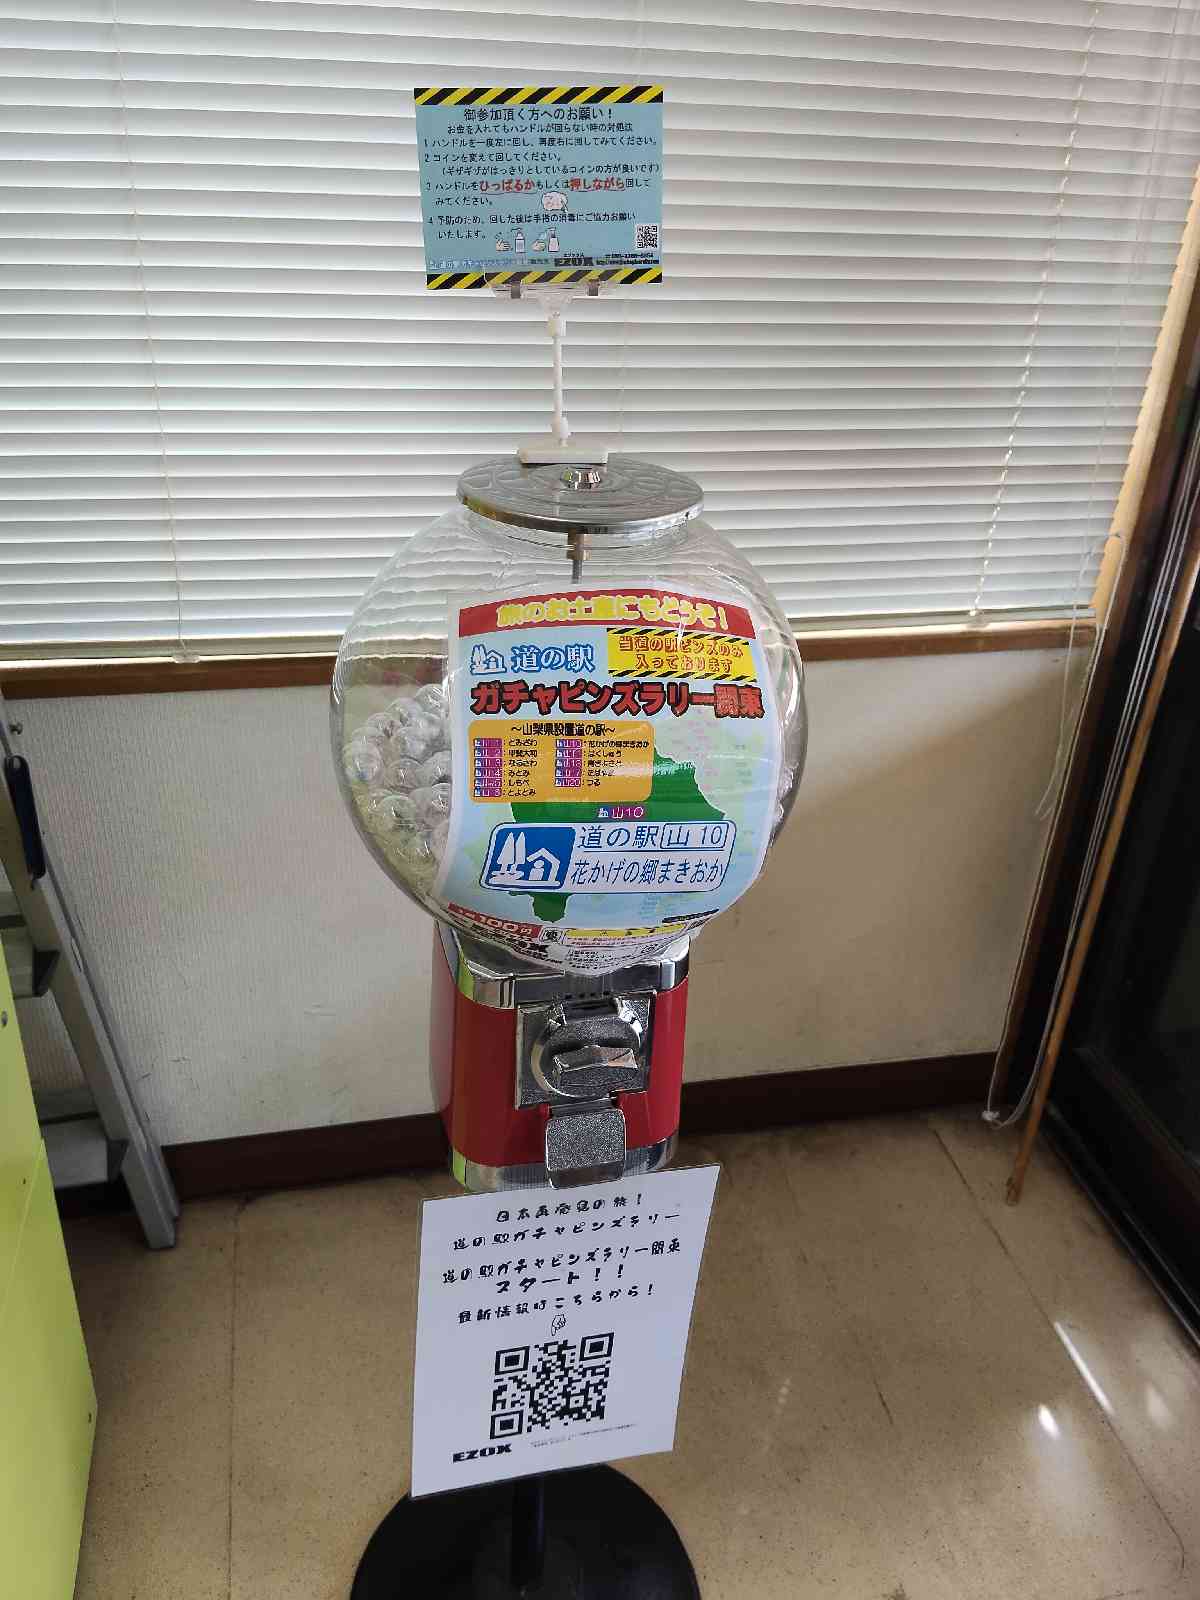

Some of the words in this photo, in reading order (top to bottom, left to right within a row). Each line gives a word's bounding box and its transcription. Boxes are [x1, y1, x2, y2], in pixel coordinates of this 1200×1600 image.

[464, 107, 613, 121] 御参加頂く方へのお願い！
[435, 196, 493, 206] みてください。
[438, 229, 486, 240] いたします。
[511, 644, 595, 674] 道の駅
[636, 653, 734, 673] 入っております
[470, 679, 765, 719] ガチャピンズラリー関東
[580, 825, 660, 849] 道の駅
[667, 826, 690, 847] 山
[699, 825, 723, 846] 10
[570, 858, 725, 885] 花かげの郷まきおか
[452, 1443, 512, 1463] EZOX
